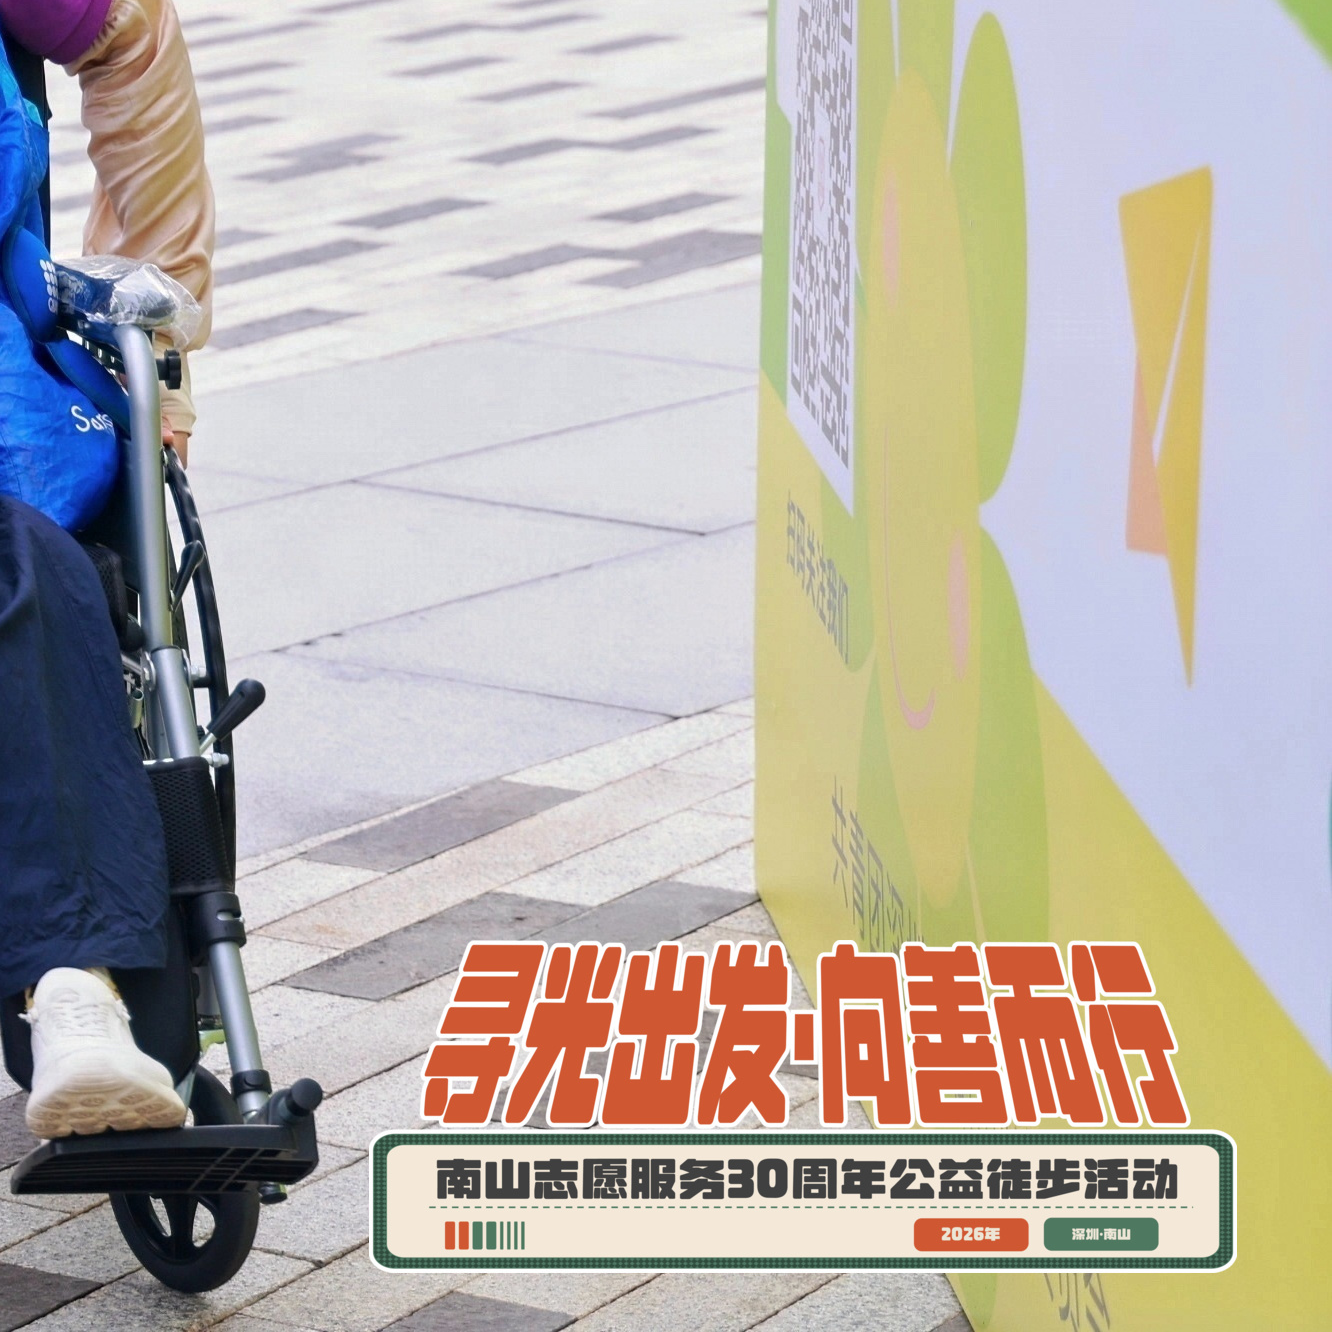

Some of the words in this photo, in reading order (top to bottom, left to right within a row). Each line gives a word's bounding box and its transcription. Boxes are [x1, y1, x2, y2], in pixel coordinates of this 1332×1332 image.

[786, 488, 849, 665] 扫码关注我们
